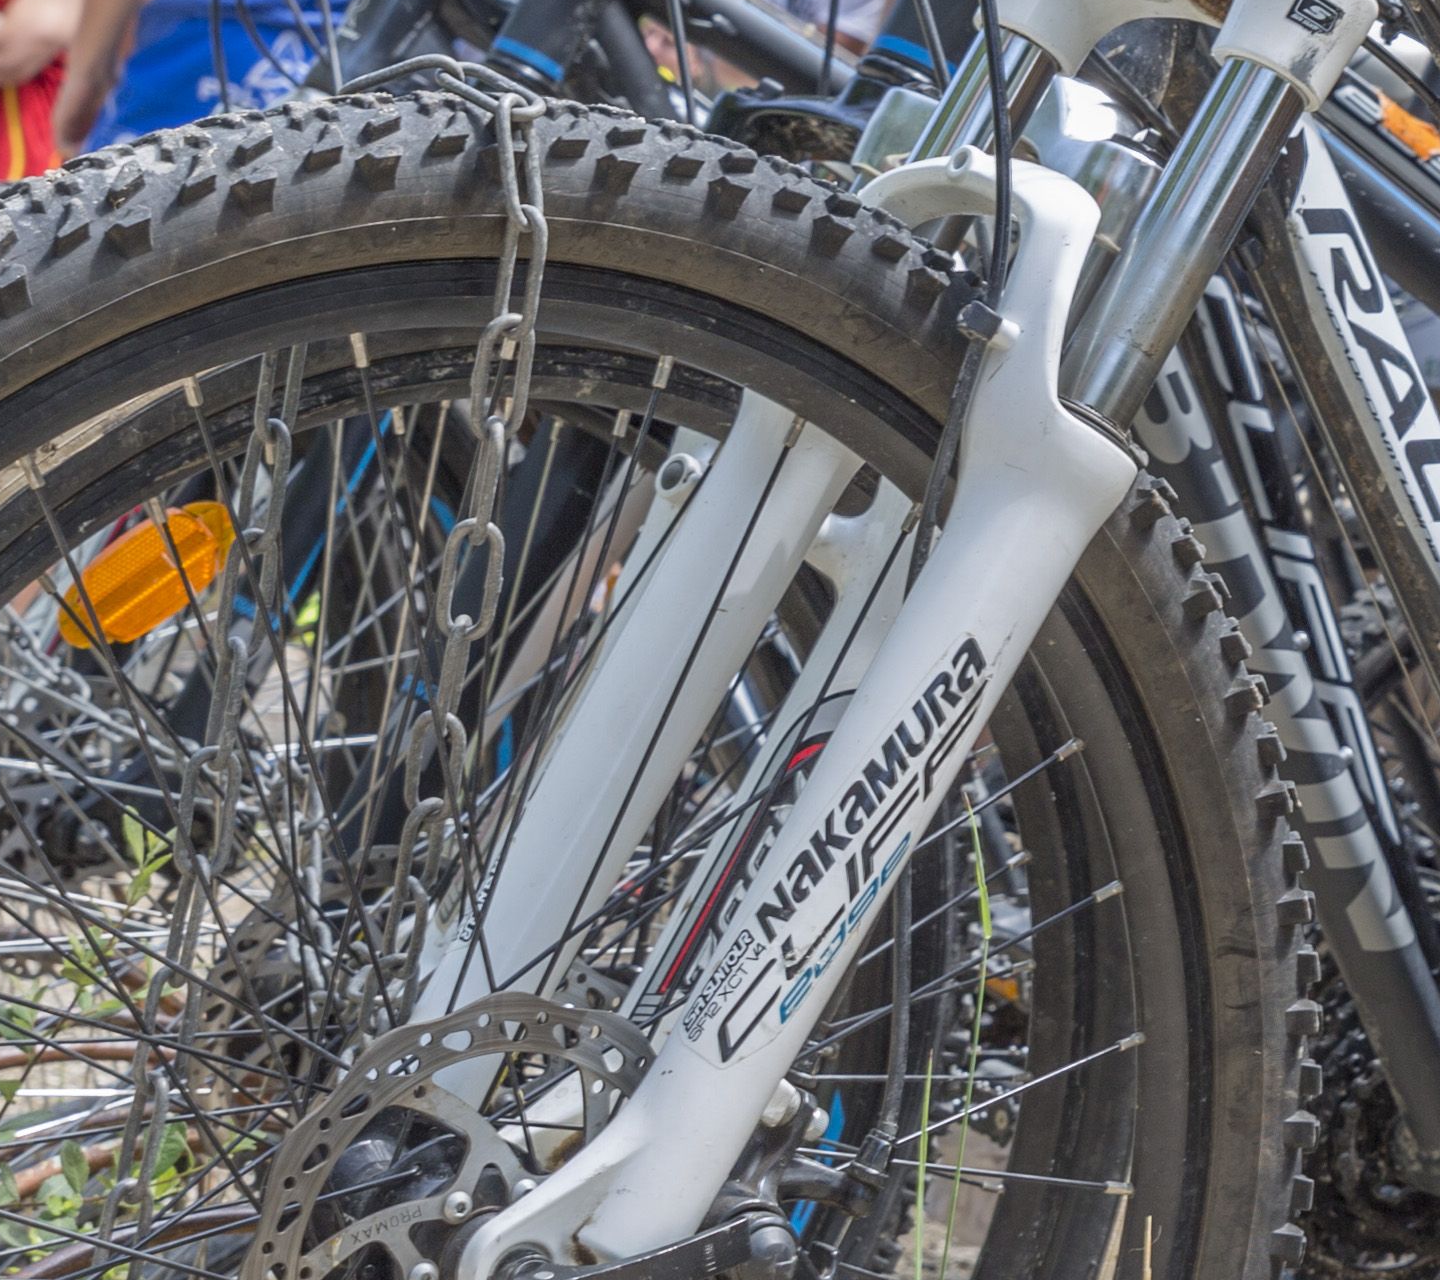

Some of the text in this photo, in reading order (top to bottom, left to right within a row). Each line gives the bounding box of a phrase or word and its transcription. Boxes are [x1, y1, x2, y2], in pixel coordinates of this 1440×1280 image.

[1196, 273, 1401, 847] CLIFF
[688, 942, 767, 1043] SF12 XCT V4
